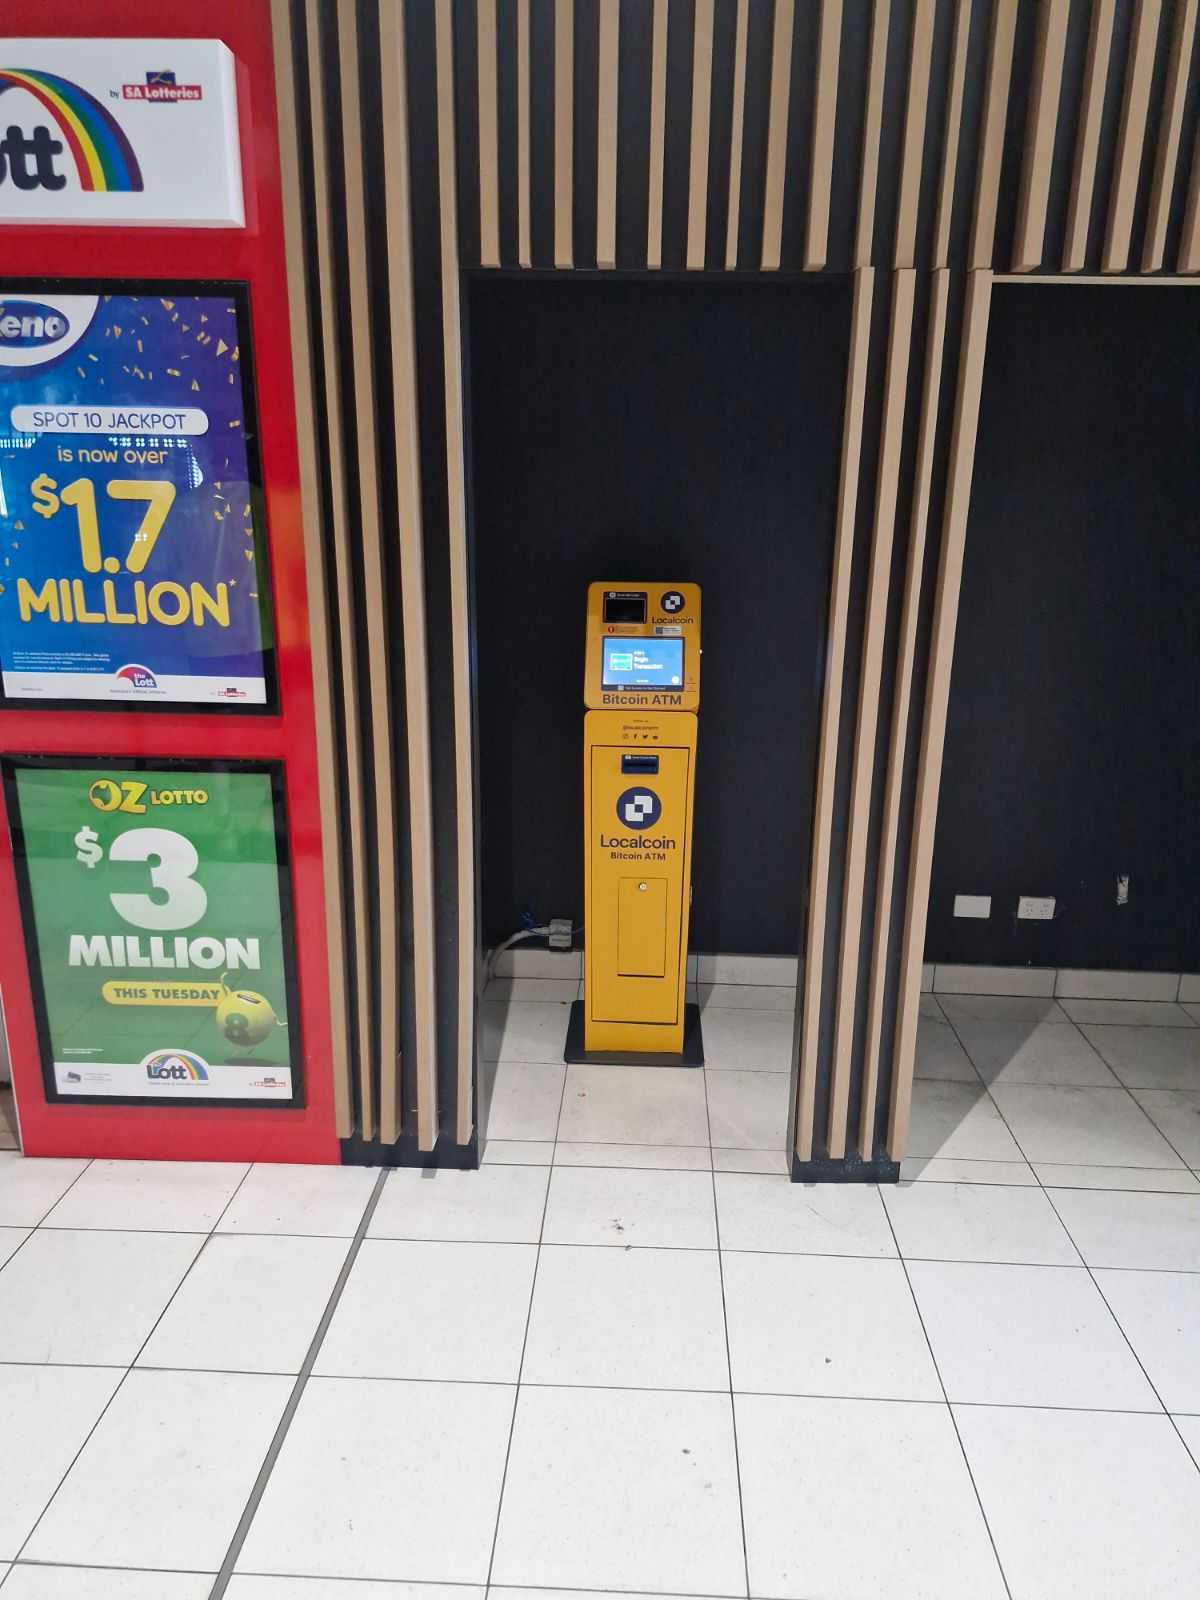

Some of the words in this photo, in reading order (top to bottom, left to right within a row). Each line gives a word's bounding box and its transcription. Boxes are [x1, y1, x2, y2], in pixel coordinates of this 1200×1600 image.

[126, 87, 142, 98] SA
[145, 87, 200, 98] Lotteries
[0, 125, 67, 191] tt
[0, 315, 66, 338] eno
[33, 412, 79, 427] SPOT
[84, 413, 102, 428] 10
[108, 413, 187, 429] JACKPOT
[57, 445, 73, 462] is
[78, 448, 118, 463] now
[124, 450, 168, 464] over
[30, 473, 177, 574] $1.7
[651, 616, 694, 625] Localcoin
[602, 694, 648, 705] Bitcoin
[652, 694, 682, 705] ATM
[89, 779, 148, 814] OZ
[150, 790, 209, 805] LOTTO
[600, 834, 676, 850] Localcoin
[610, 851, 642, 861] Bitcoin
[644, 852, 666, 861] ATM
[68, 935, 261, 970] MILLION
[113, 987, 148, 1000] THIS
[152, 988, 220, 1001] TUESDAY
[146, 1064, 187, 1080] Lott
